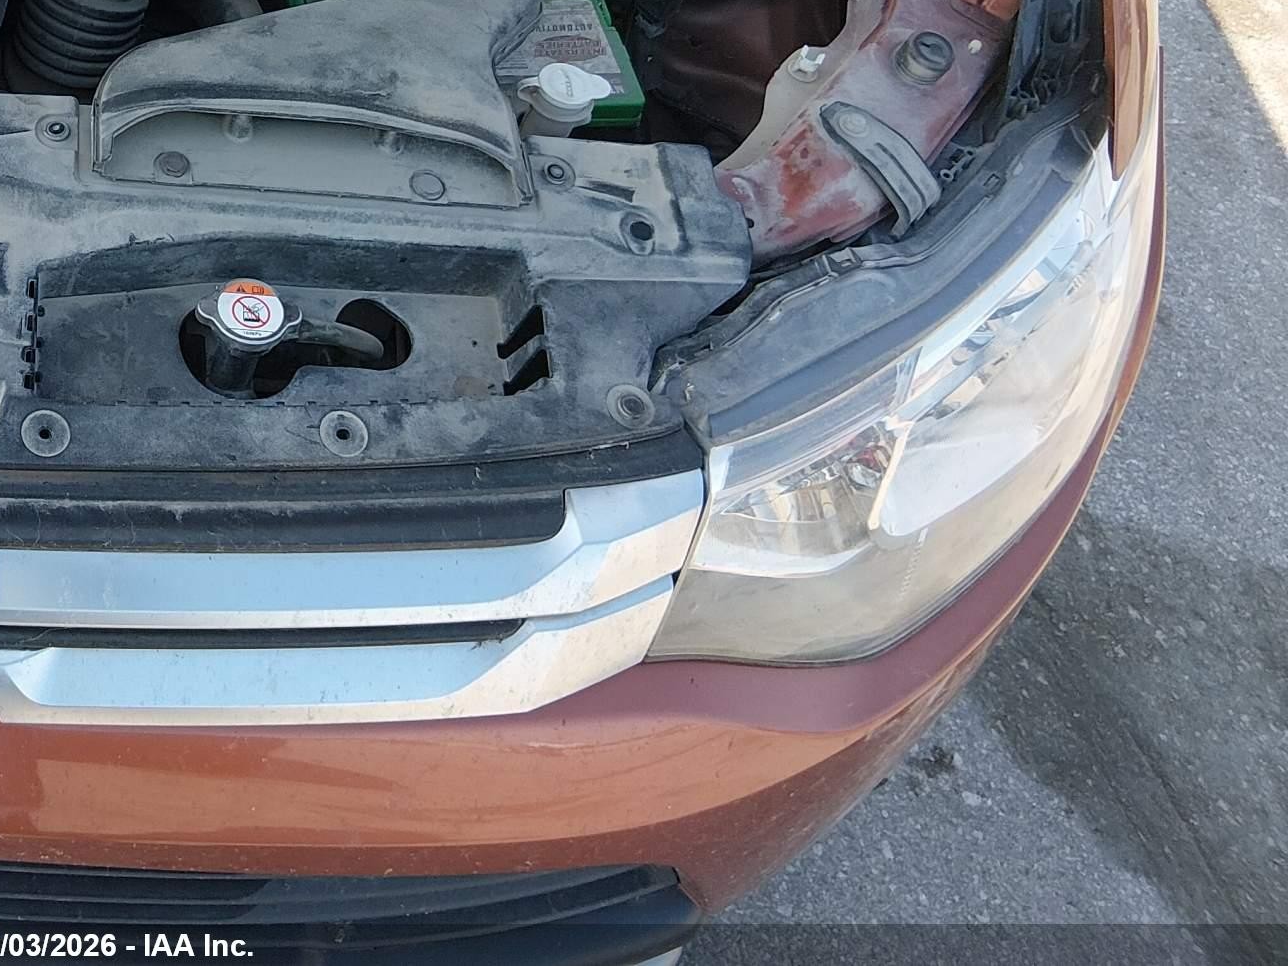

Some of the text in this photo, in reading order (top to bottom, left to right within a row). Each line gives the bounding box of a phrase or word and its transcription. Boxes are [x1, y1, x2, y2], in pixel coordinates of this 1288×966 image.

[534, 23, 593, 33] AUTOMOTIV
[535, 40, 603, 49] BATTERIES
[534, 48, 607, 58] INTERSTATE
